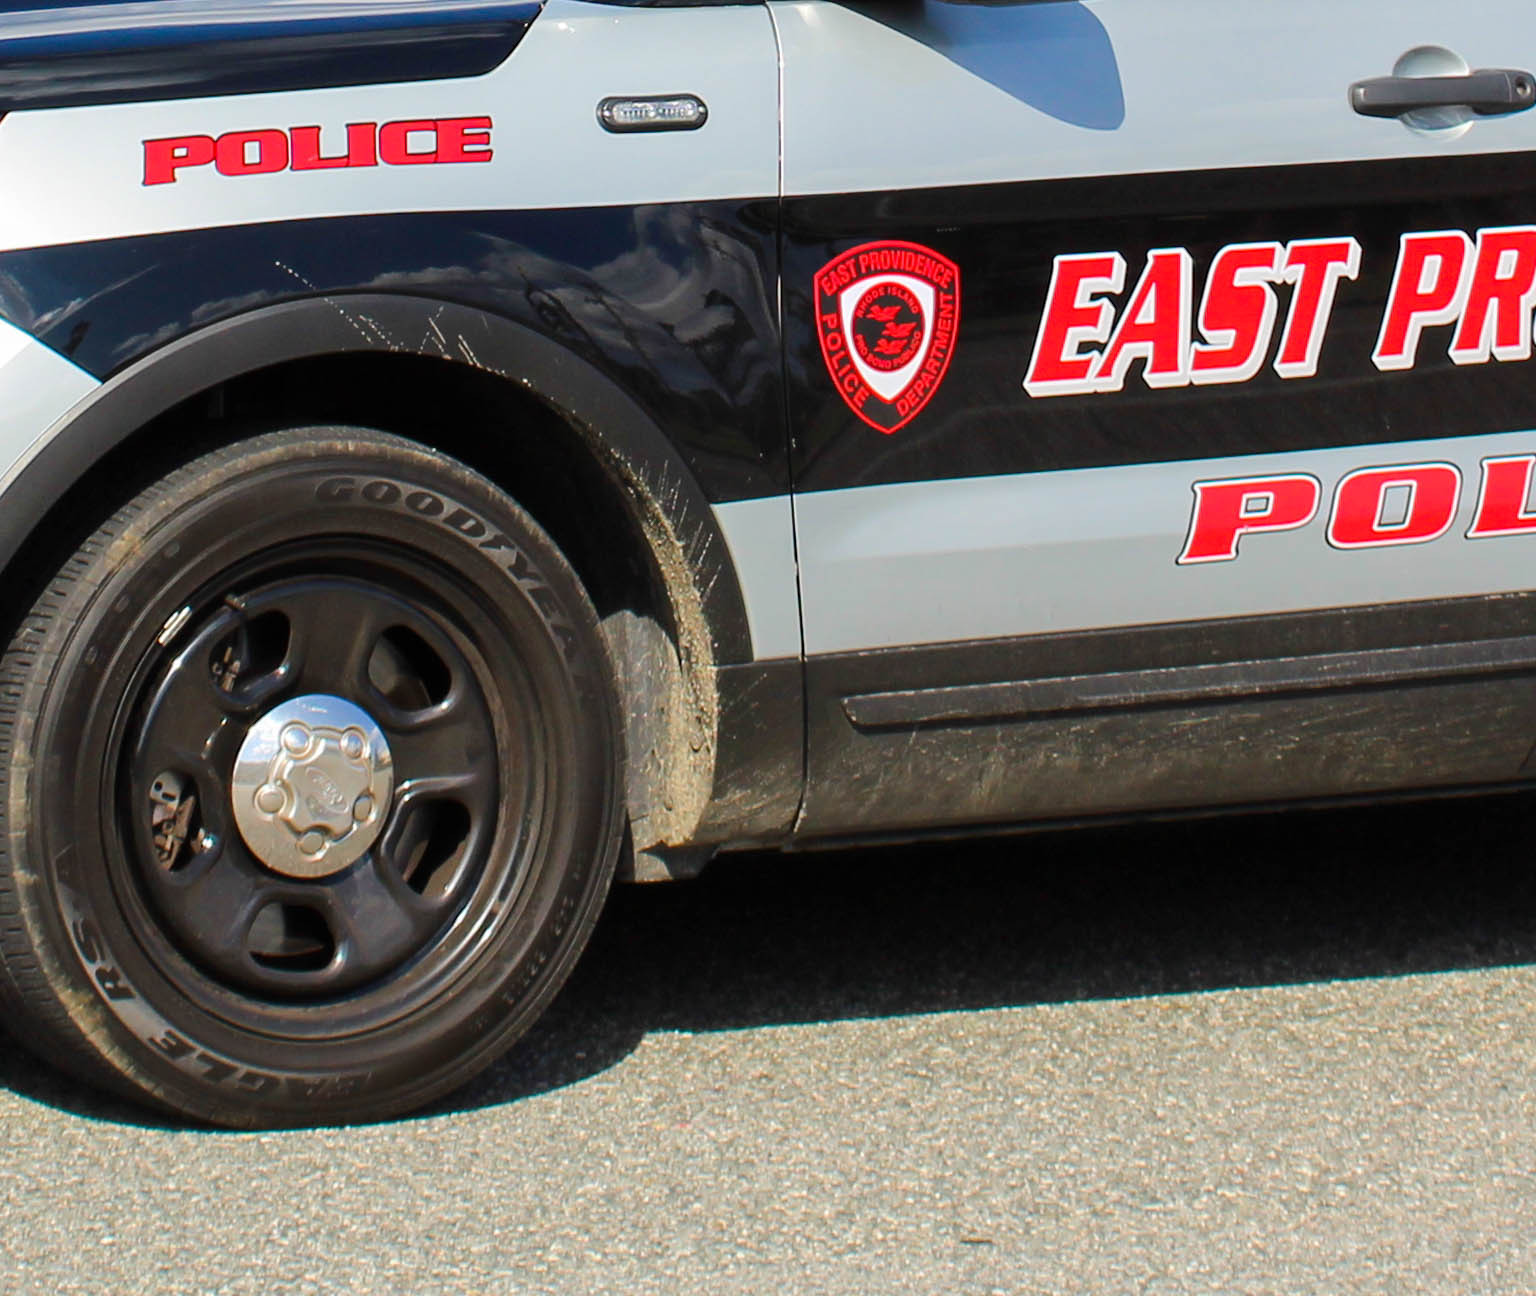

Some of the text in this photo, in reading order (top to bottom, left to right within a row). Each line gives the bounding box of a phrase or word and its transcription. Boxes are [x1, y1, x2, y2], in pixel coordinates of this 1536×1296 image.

[141, 115, 494, 186] POLICE
[820, 249, 953, 297] EAST PROVIDENCE
[887, 285, 920, 315] ISLAND
[895, 291, 954, 417] DEPARTMENT
[1022, 236, 1363, 398] EAST
[821, 312, 870, 408] POLICE
